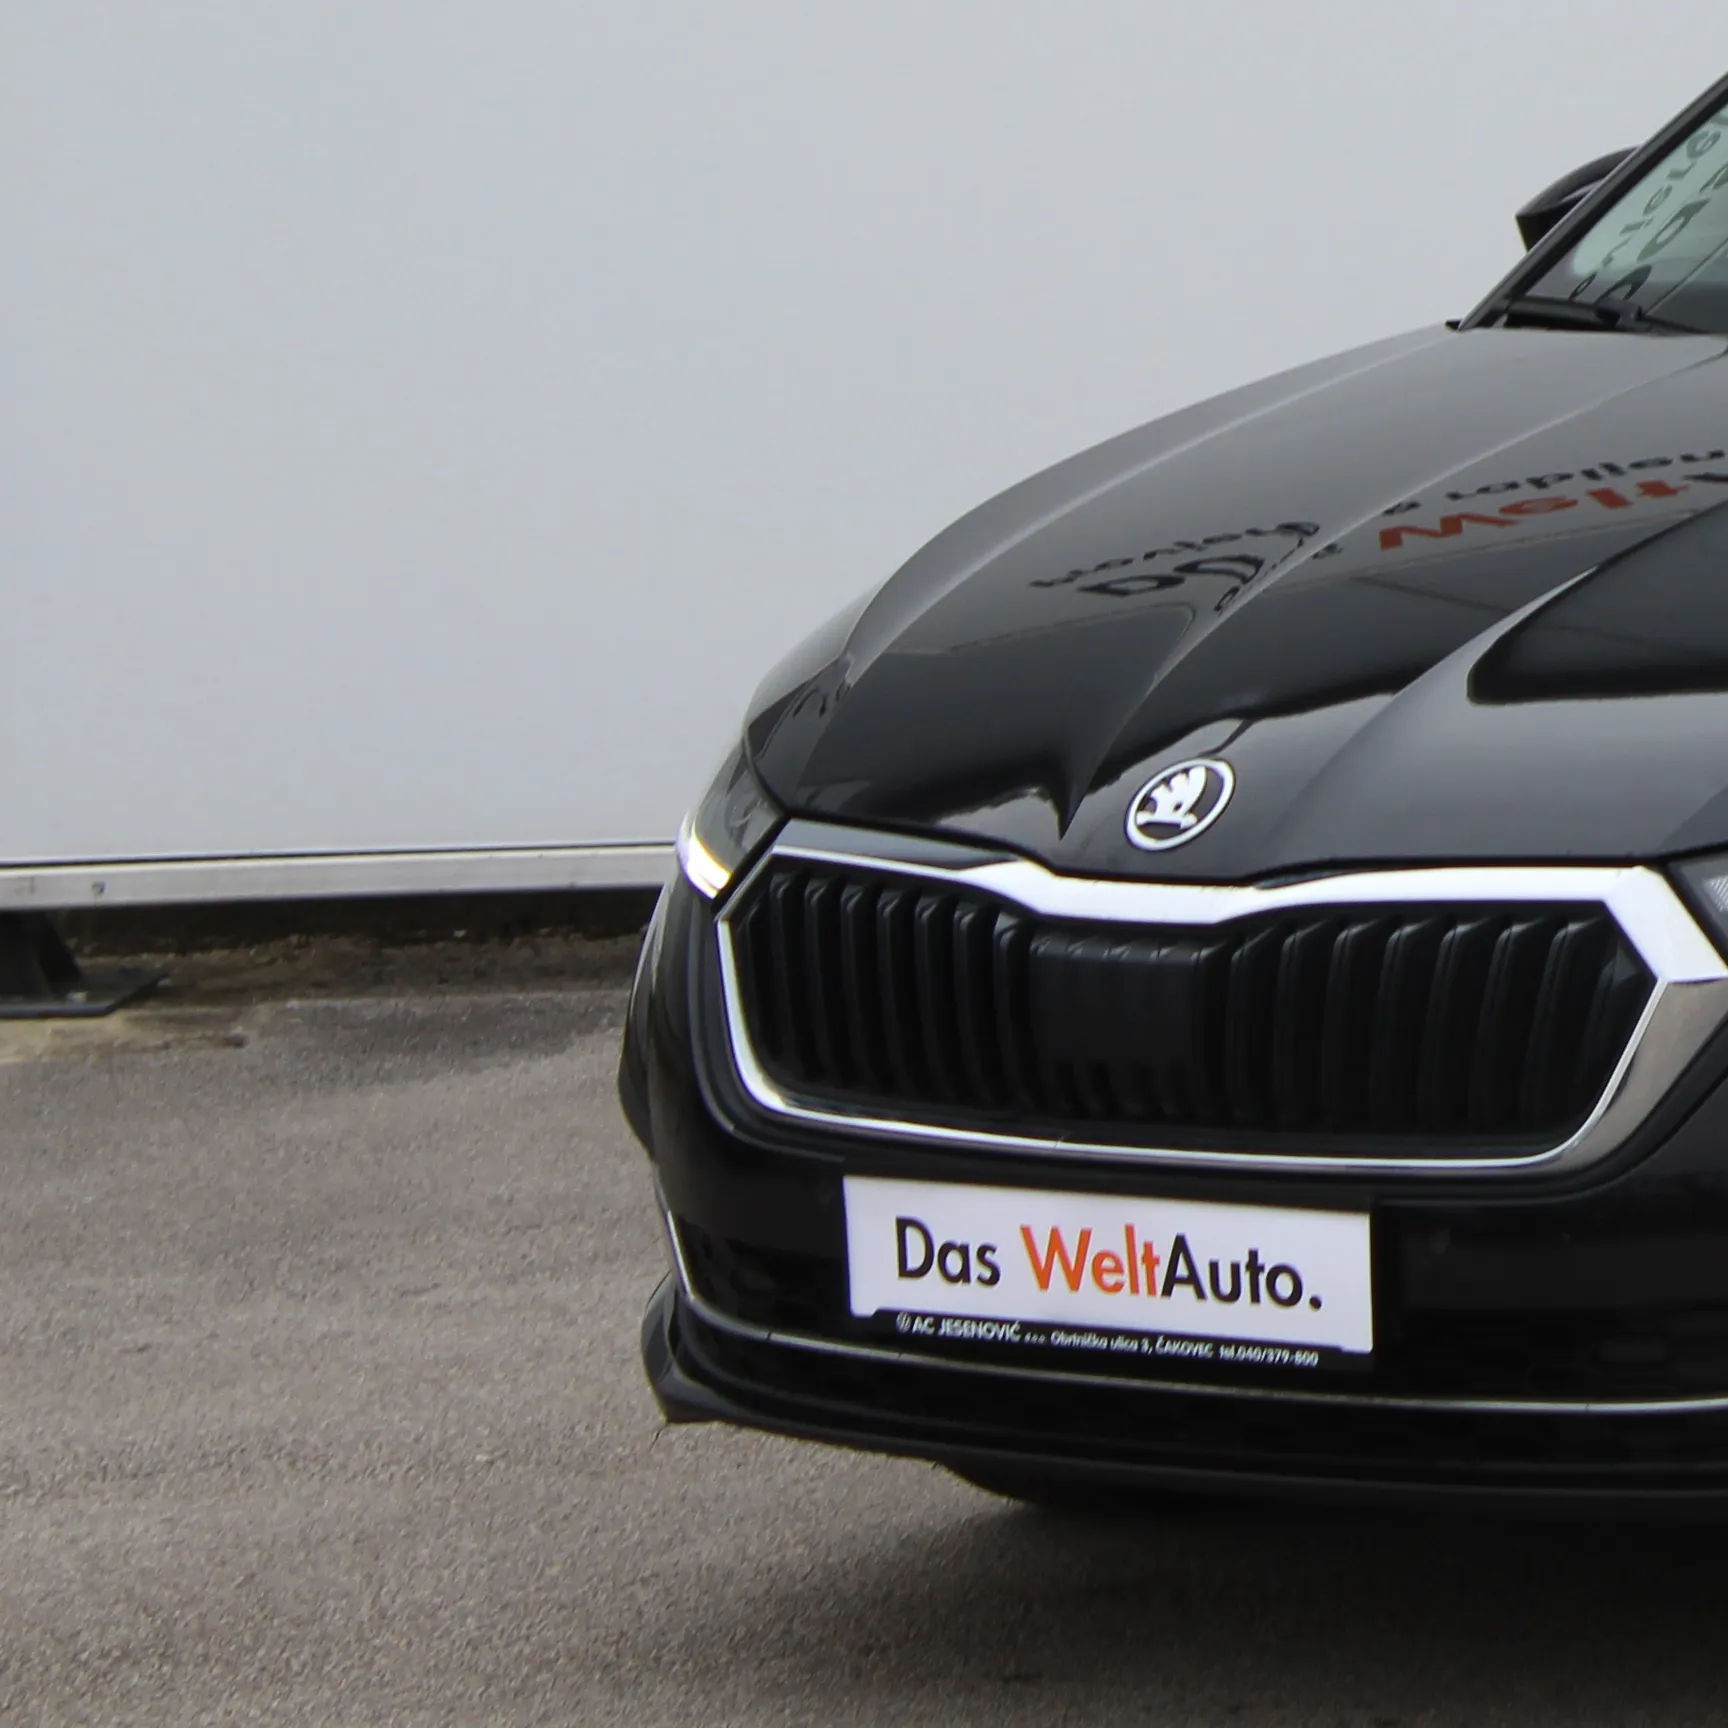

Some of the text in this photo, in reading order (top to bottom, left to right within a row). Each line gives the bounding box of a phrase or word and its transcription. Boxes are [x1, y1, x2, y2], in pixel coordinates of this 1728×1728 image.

[896, 1216, 1323, 1310] Das WeltAuto.
[913, 1316, 935, 1335] AC
[939, 1319, 1021, 1342] JESENOVIĆ
